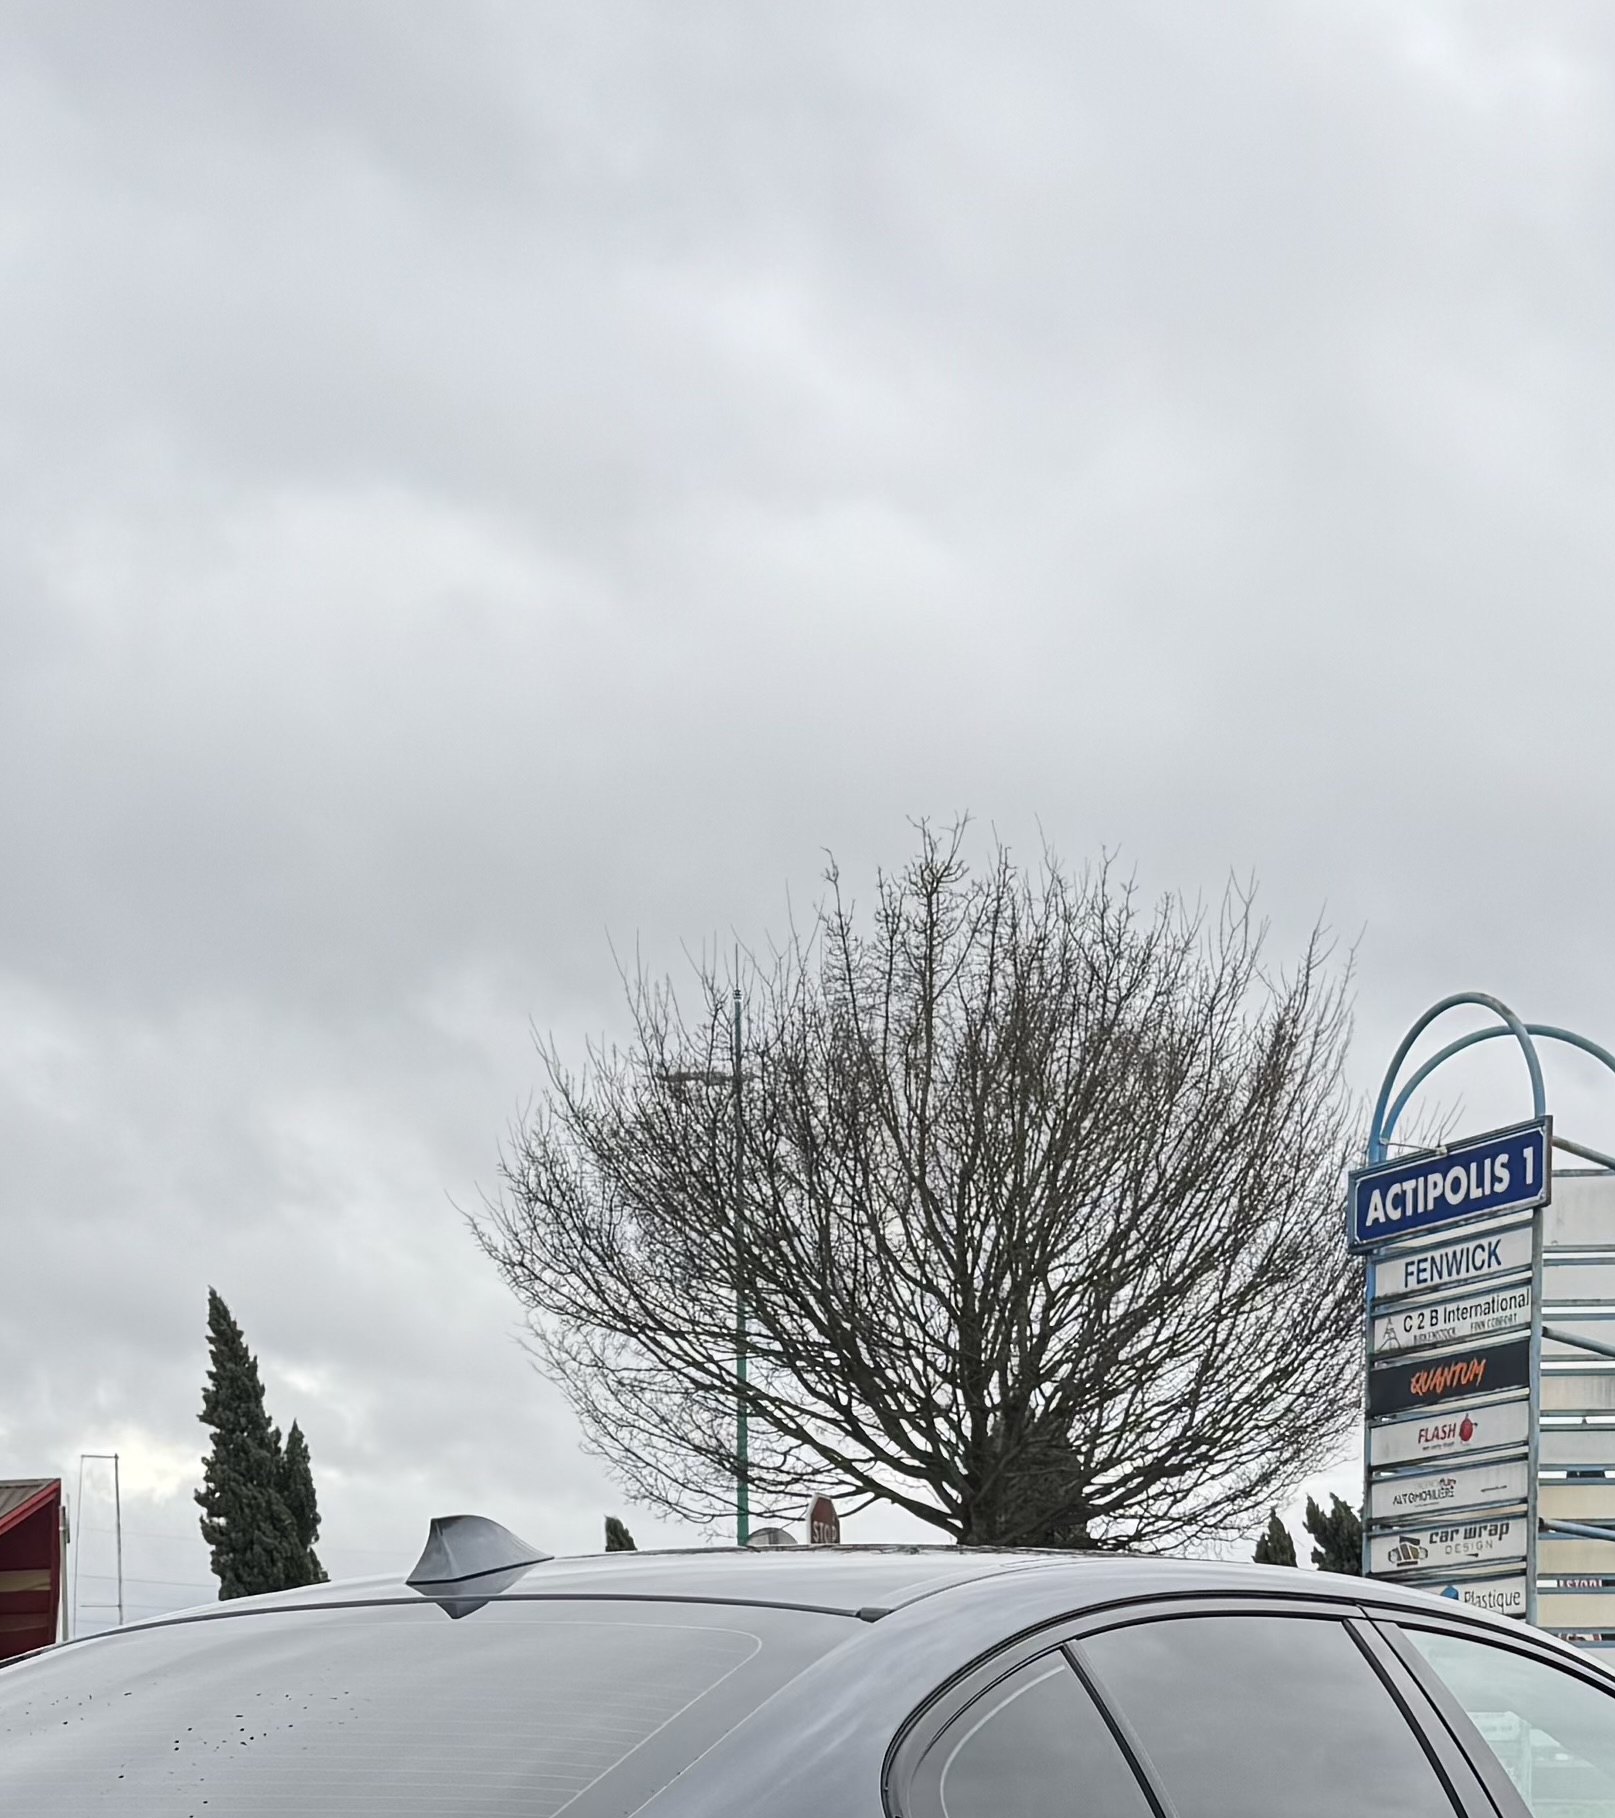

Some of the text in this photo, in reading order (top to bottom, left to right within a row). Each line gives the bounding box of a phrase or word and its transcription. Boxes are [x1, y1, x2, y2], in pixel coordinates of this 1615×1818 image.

[1365, 1146, 1534, 1227] ACTIPOLIS 1
[1404, 1238, 1502, 1289] FENWICK
[1403, 1288, 1530, 1333] C 2 B International
[1410, 1356, 1487, 1397] QUANTUM
[1418, 1422, 1457, 1445] FLASH
[813, 1520, 838, 1543] STOP
[1429, 1521, 1510, 1545] car wrap
[1445, 1540, 1493, 1555] DESIGN
[1464, 1589, 1521, 1613] Plastique
